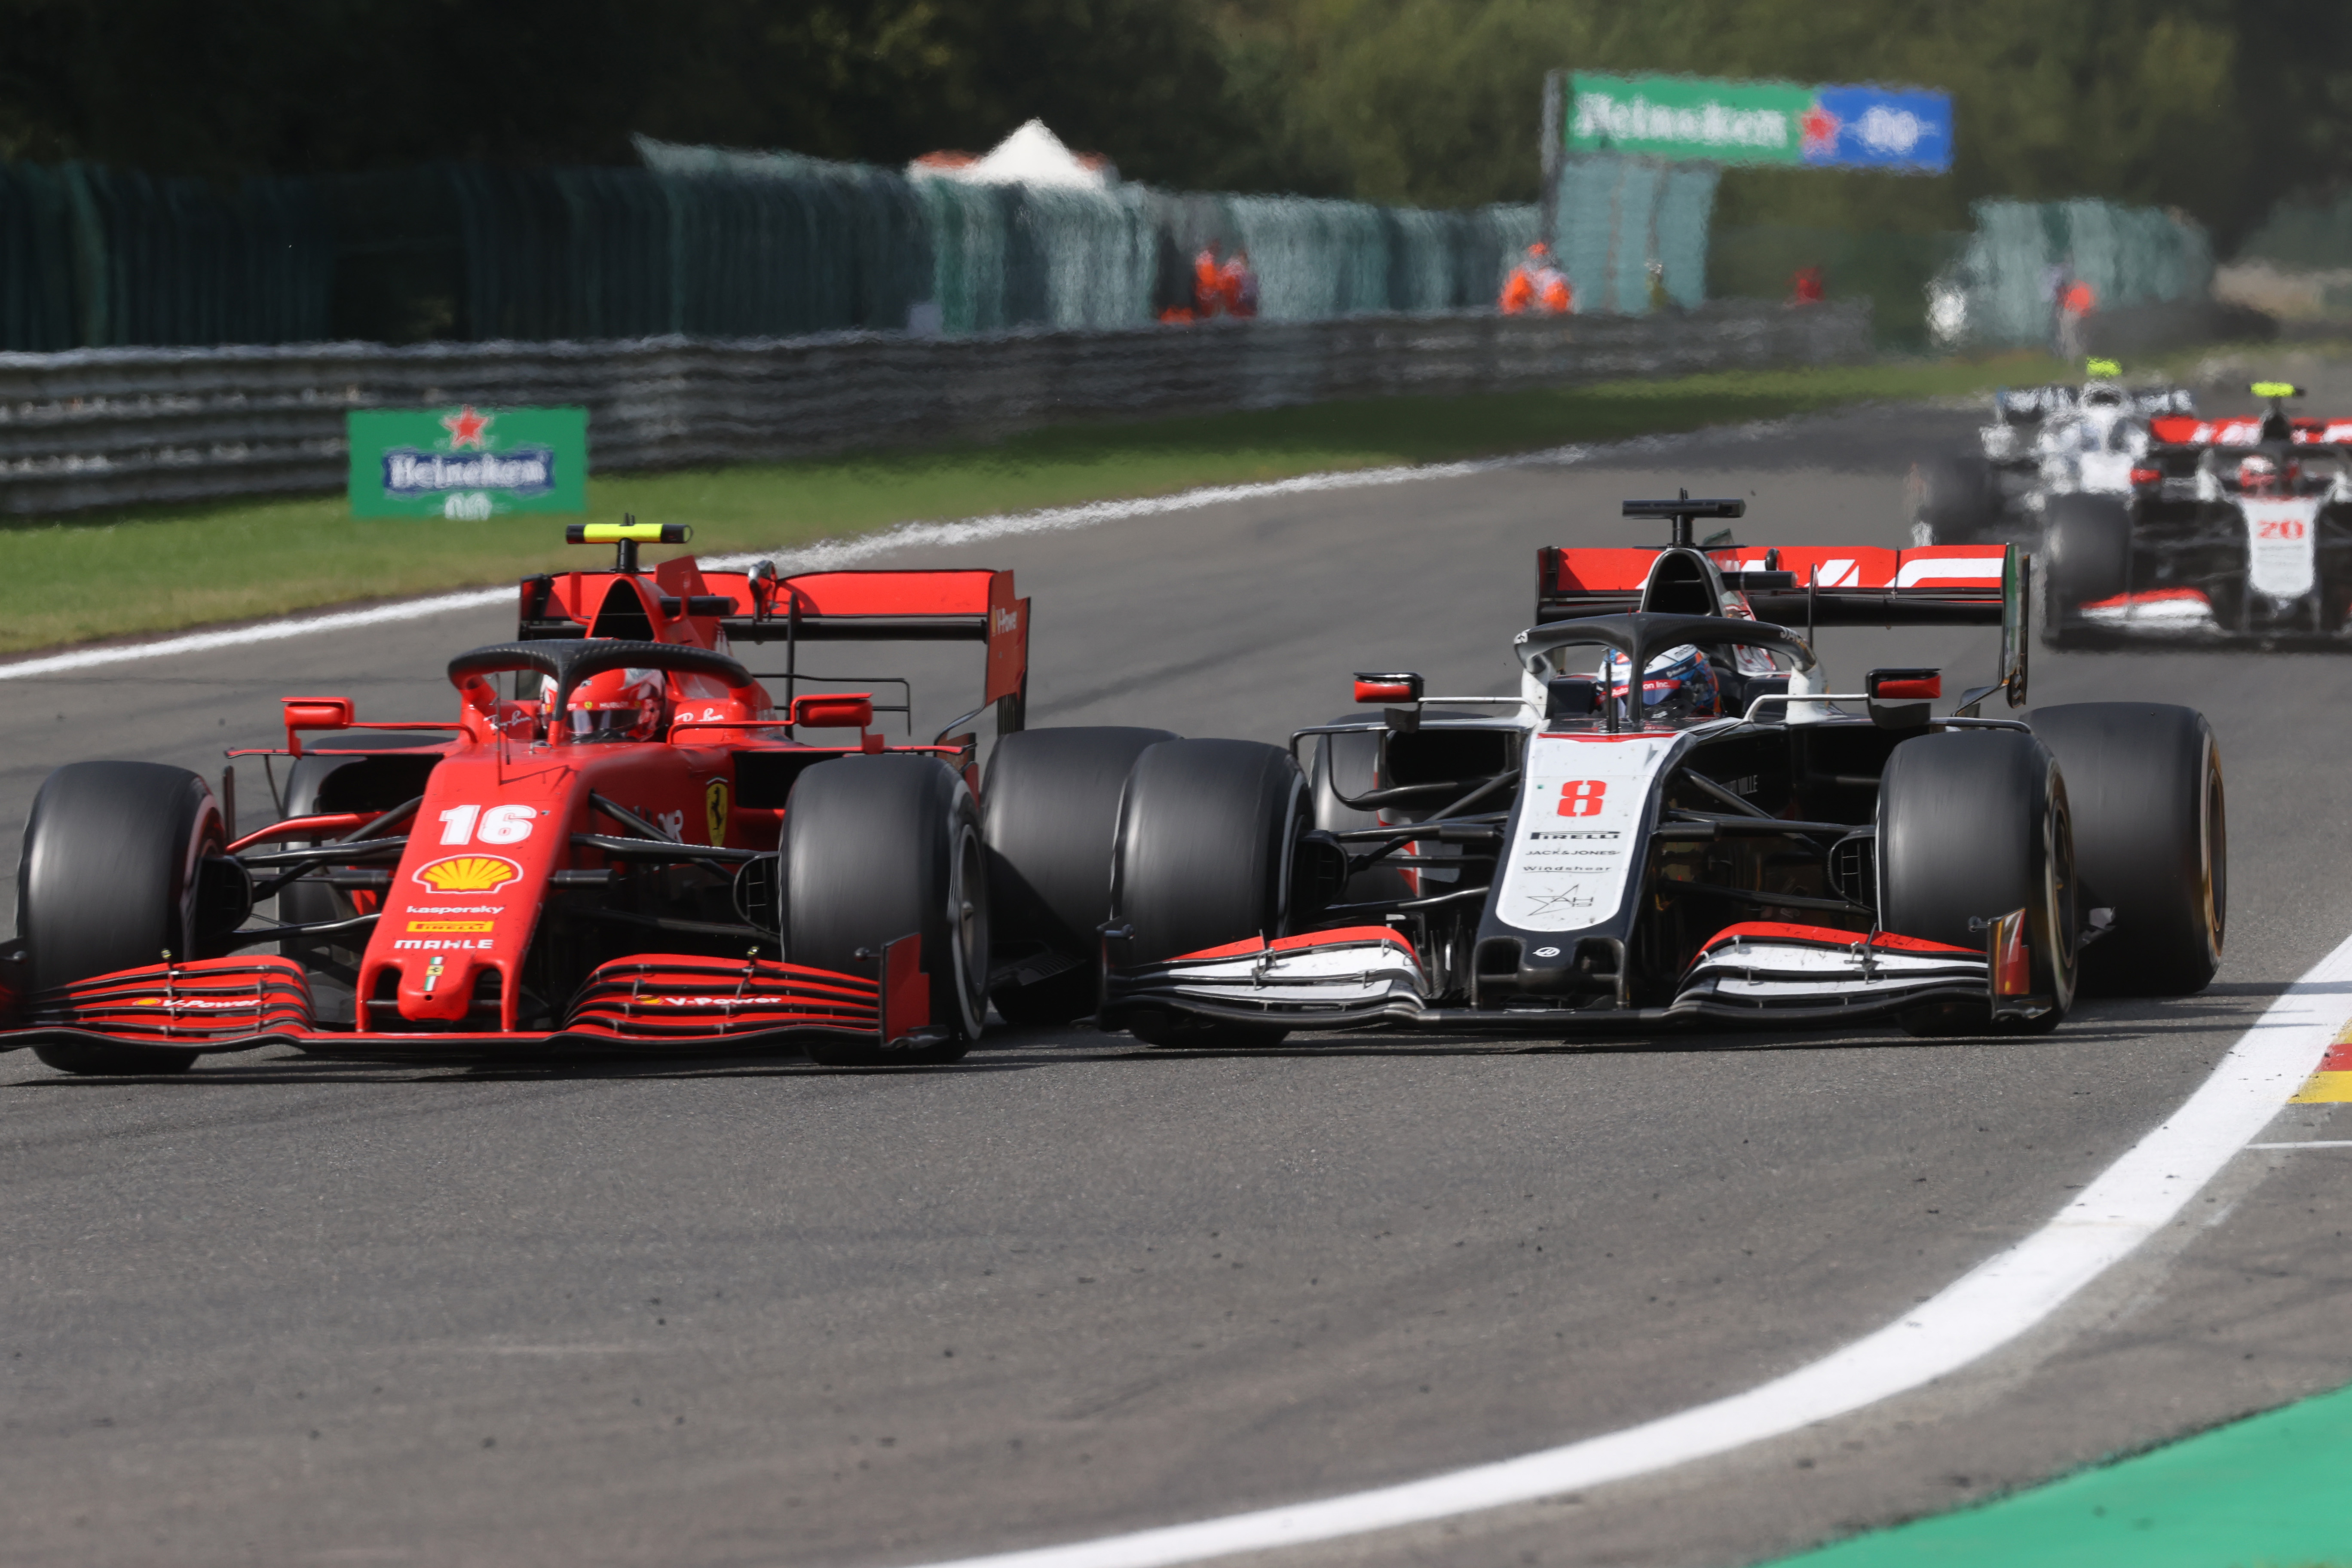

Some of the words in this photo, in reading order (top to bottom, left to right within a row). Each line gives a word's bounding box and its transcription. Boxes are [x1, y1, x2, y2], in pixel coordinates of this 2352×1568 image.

[389, 454, 547, 489] Heineken
[2257, 520, 2304, 539] 20
[1556, 780, 1607, 817] 8
[438, 805, 538, 845] 16
[1530, 831, 1621, 840] PIRELLI
[406, 906, 505, 915] kaspersky
[394, 939, 494, 949] MAHLE
[162, 999, 261, 1008] V-Power
[665, 997, 781, 1006] V-Power
